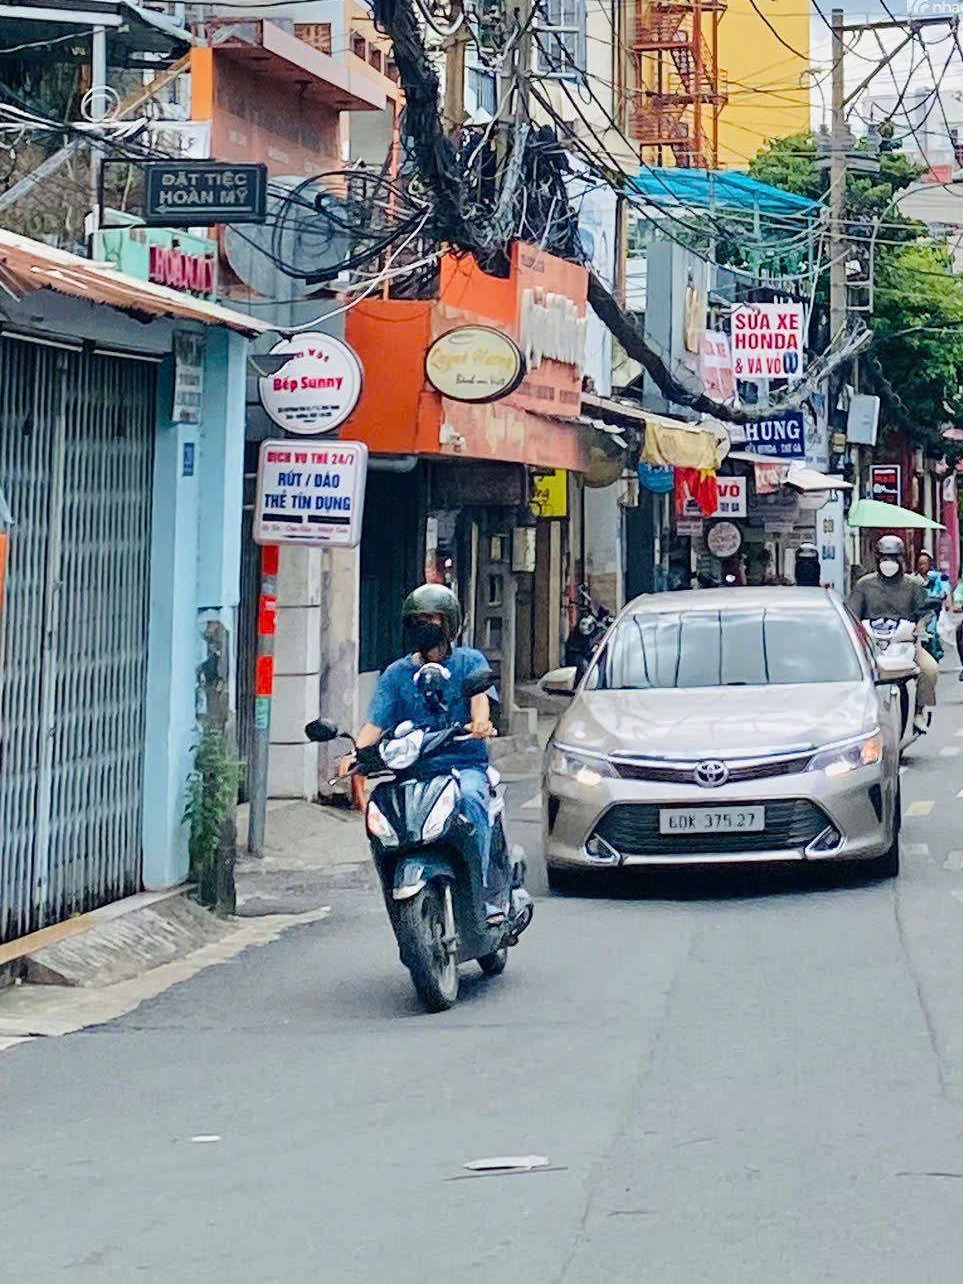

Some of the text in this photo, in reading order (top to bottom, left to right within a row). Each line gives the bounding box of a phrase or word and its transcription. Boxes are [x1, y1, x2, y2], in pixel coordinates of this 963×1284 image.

[205, 171, 248, 188] TIỆC
[159, 188, 213, 204] HOÀN
[776, 313, 799, 330] XE
[735, 333, 798, 350] HONDA
[735, 357, 743, 374] &
[301, 376, 344, 391] Sunny
[331, 453, 354, 465] 24/7
[278, 469, 303, 487] RÚT
[305, 473, 311, 487] /
[265, 489, 351, 513] THẺ TÍN DỤNG
